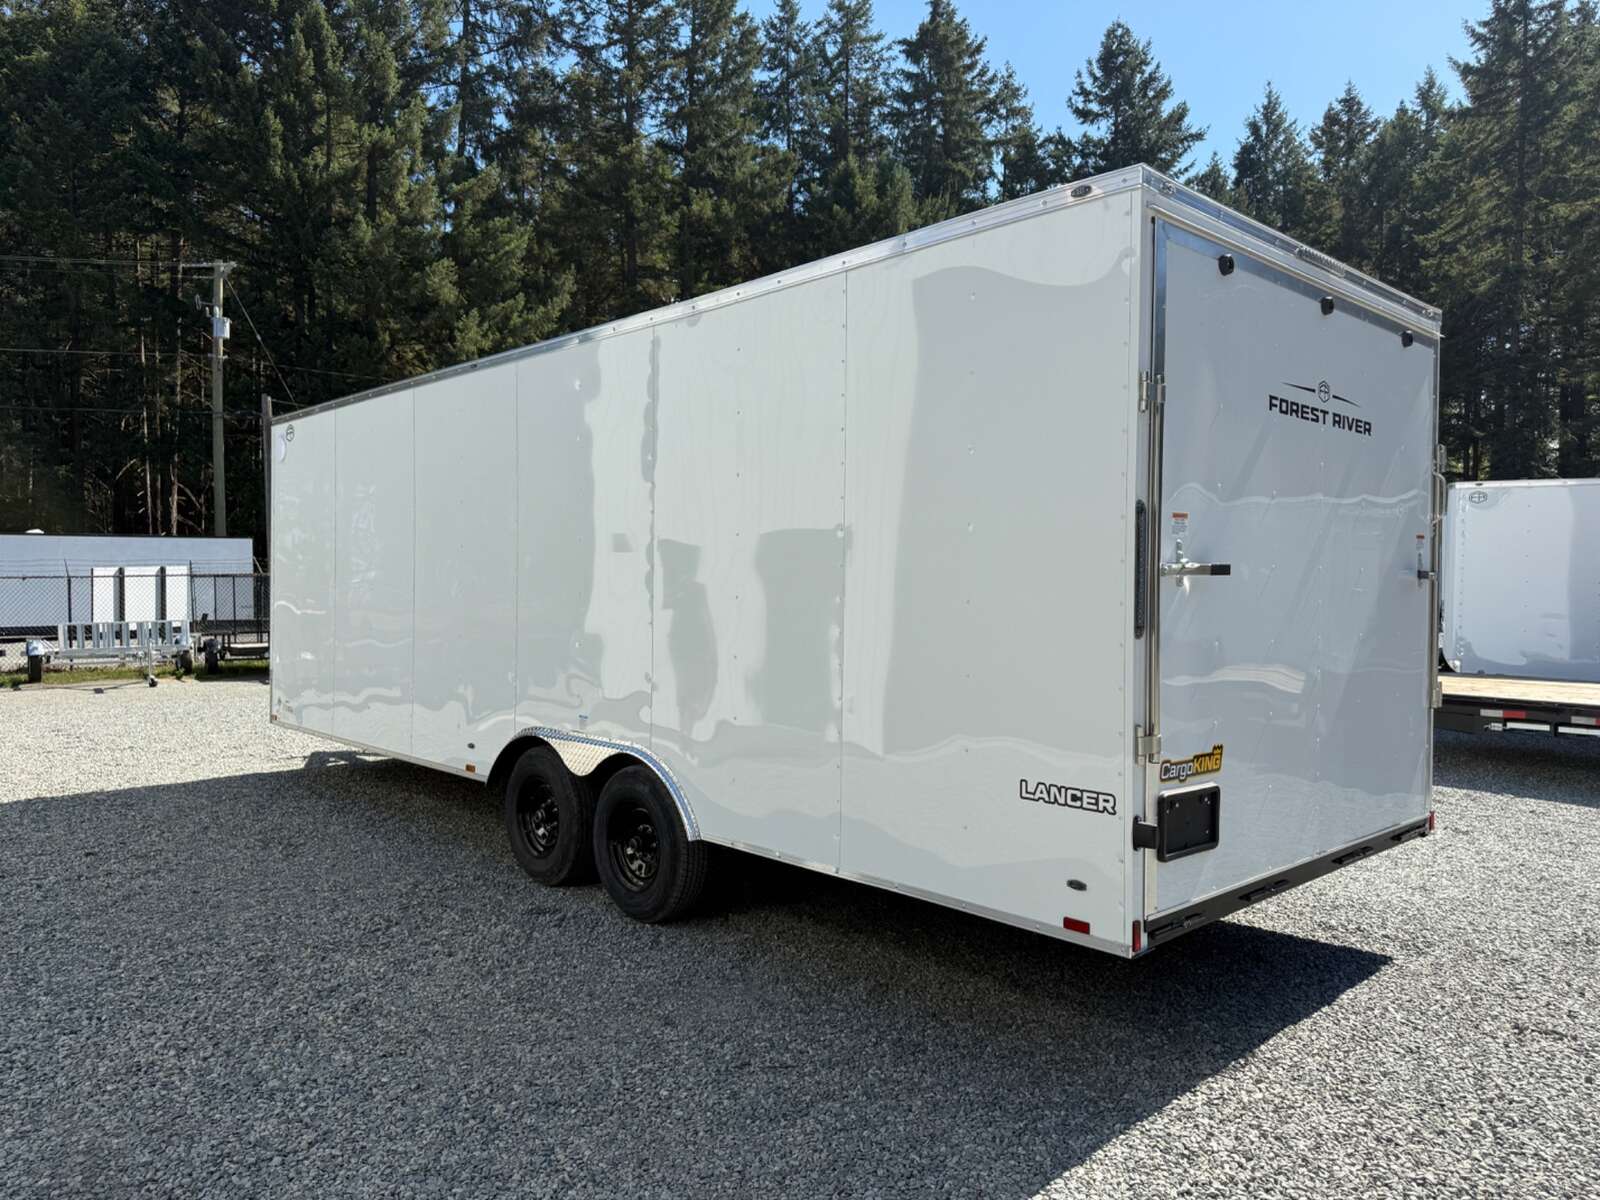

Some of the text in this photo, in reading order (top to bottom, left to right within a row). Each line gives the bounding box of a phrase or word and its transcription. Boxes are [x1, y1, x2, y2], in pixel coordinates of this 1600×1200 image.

[1268, 394, 1372, 436] FOREST RIVER
[1160, 750, 1222, 781] CargoKING
[1020, 779, 1117, 815] LANCER
